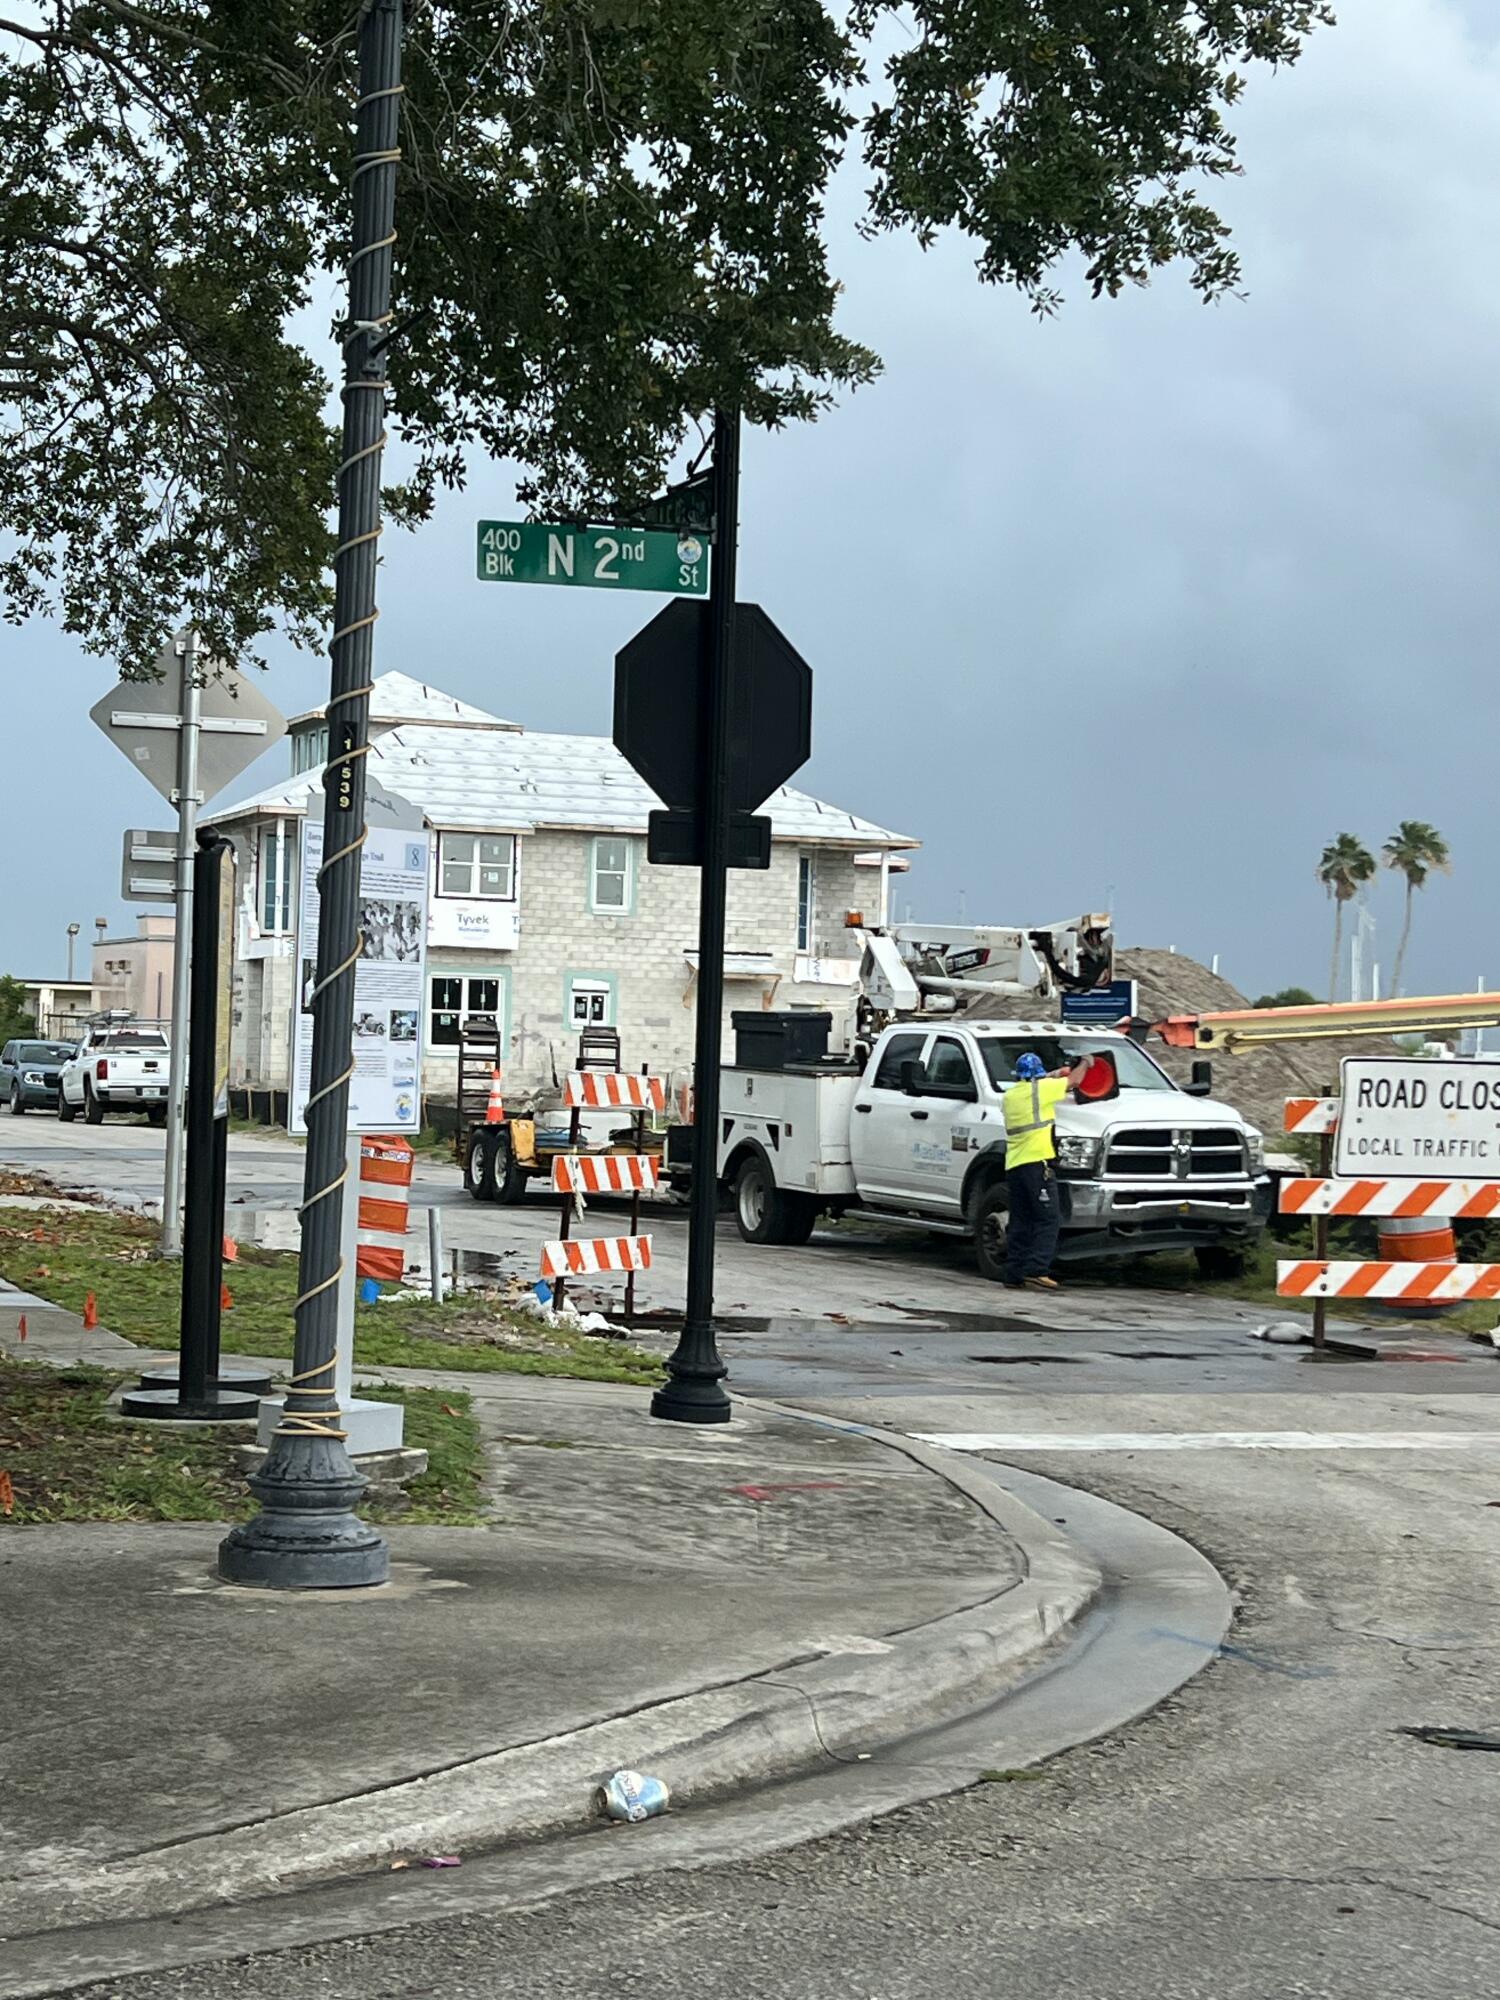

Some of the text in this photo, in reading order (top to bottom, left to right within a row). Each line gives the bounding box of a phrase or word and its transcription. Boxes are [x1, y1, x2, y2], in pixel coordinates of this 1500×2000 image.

[481, 528, 521, 551] 400
[485, 552, 514, 576] Blk
[548, 534, 699, 587] N 2nd St
[411, 847, 420, 867] 8
[457, 913, 489, 926] Tyvek
[1358, 1078, 1500, 1110] ROAD CLOS
[1347, 1138, 1403, 1155] LOCAL
[1413, 1139, 1489, 1157] TRAFFIC
